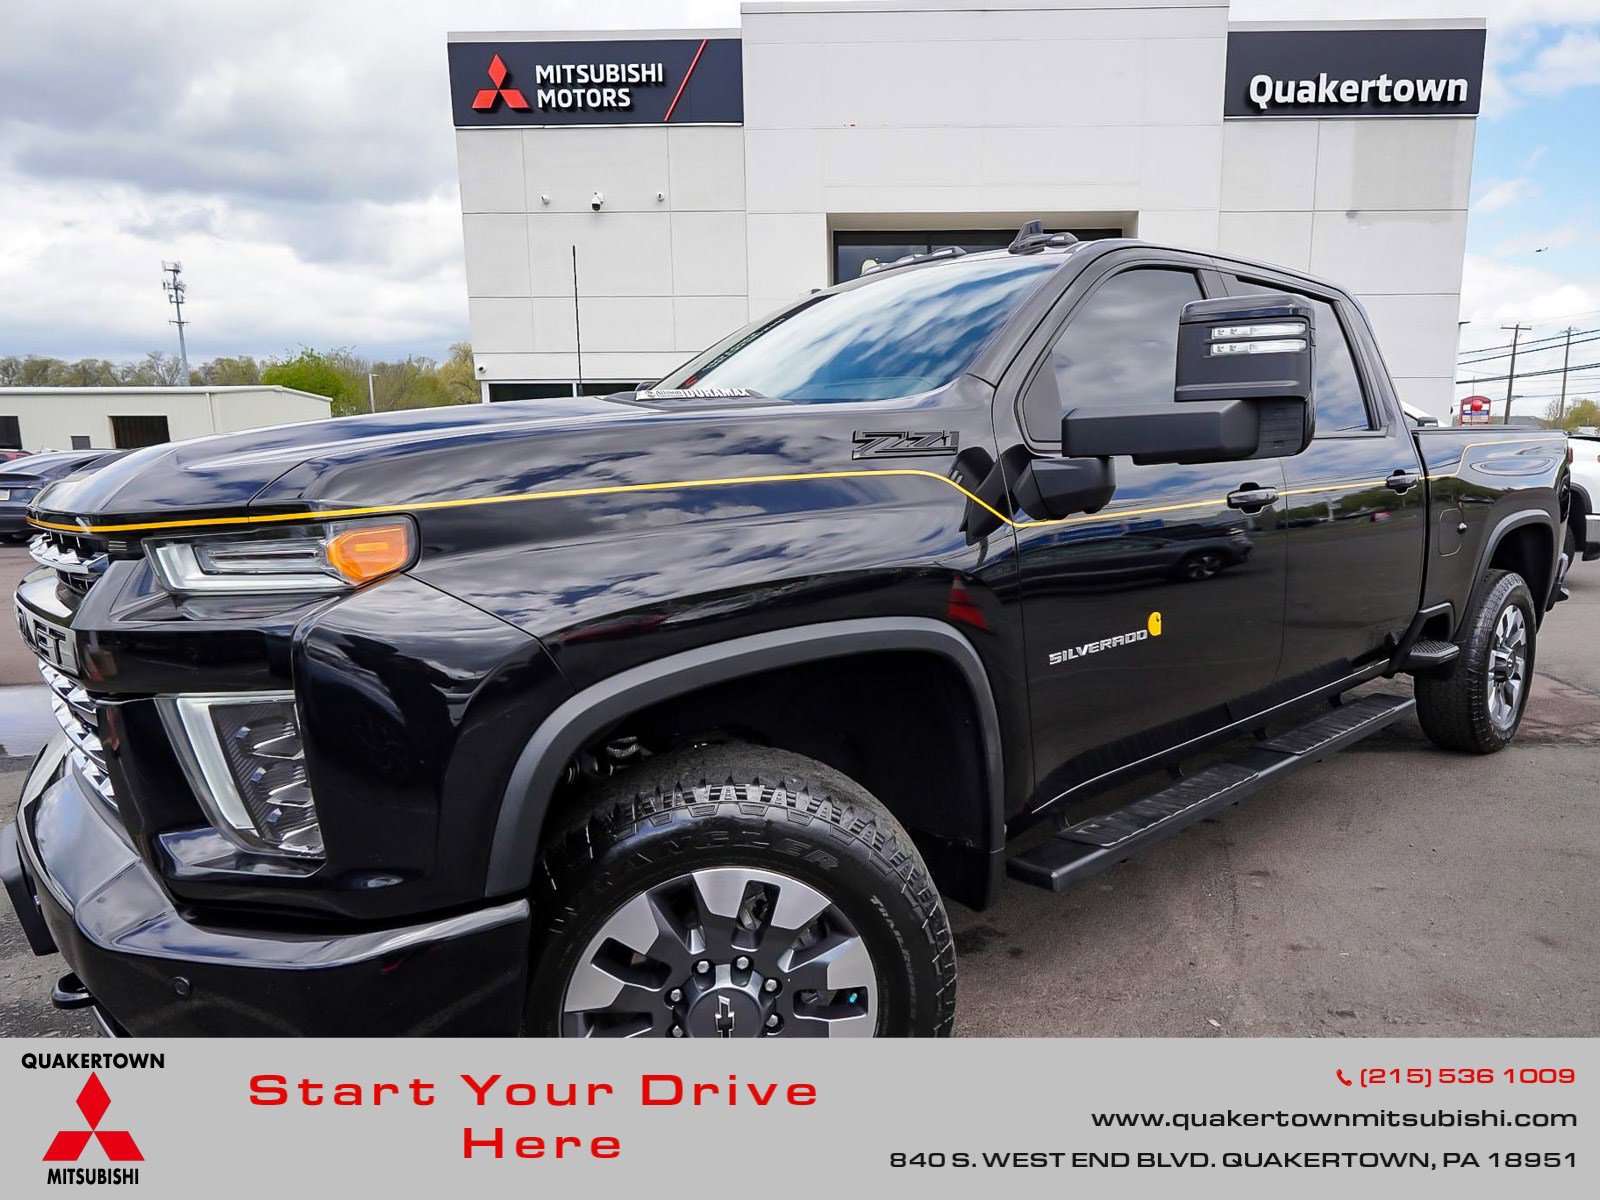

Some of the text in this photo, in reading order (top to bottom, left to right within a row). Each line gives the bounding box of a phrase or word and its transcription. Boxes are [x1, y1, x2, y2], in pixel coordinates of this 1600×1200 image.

[535, 62, 663, 84] MITSUBISHI
[537, 88, 631, 109] MOTORS
[1250, 72, 1469, 110] Quakertown
[683, 387, 751, 398] DURAMAX
[1048, 629, 1148, 666] SILVERADO
